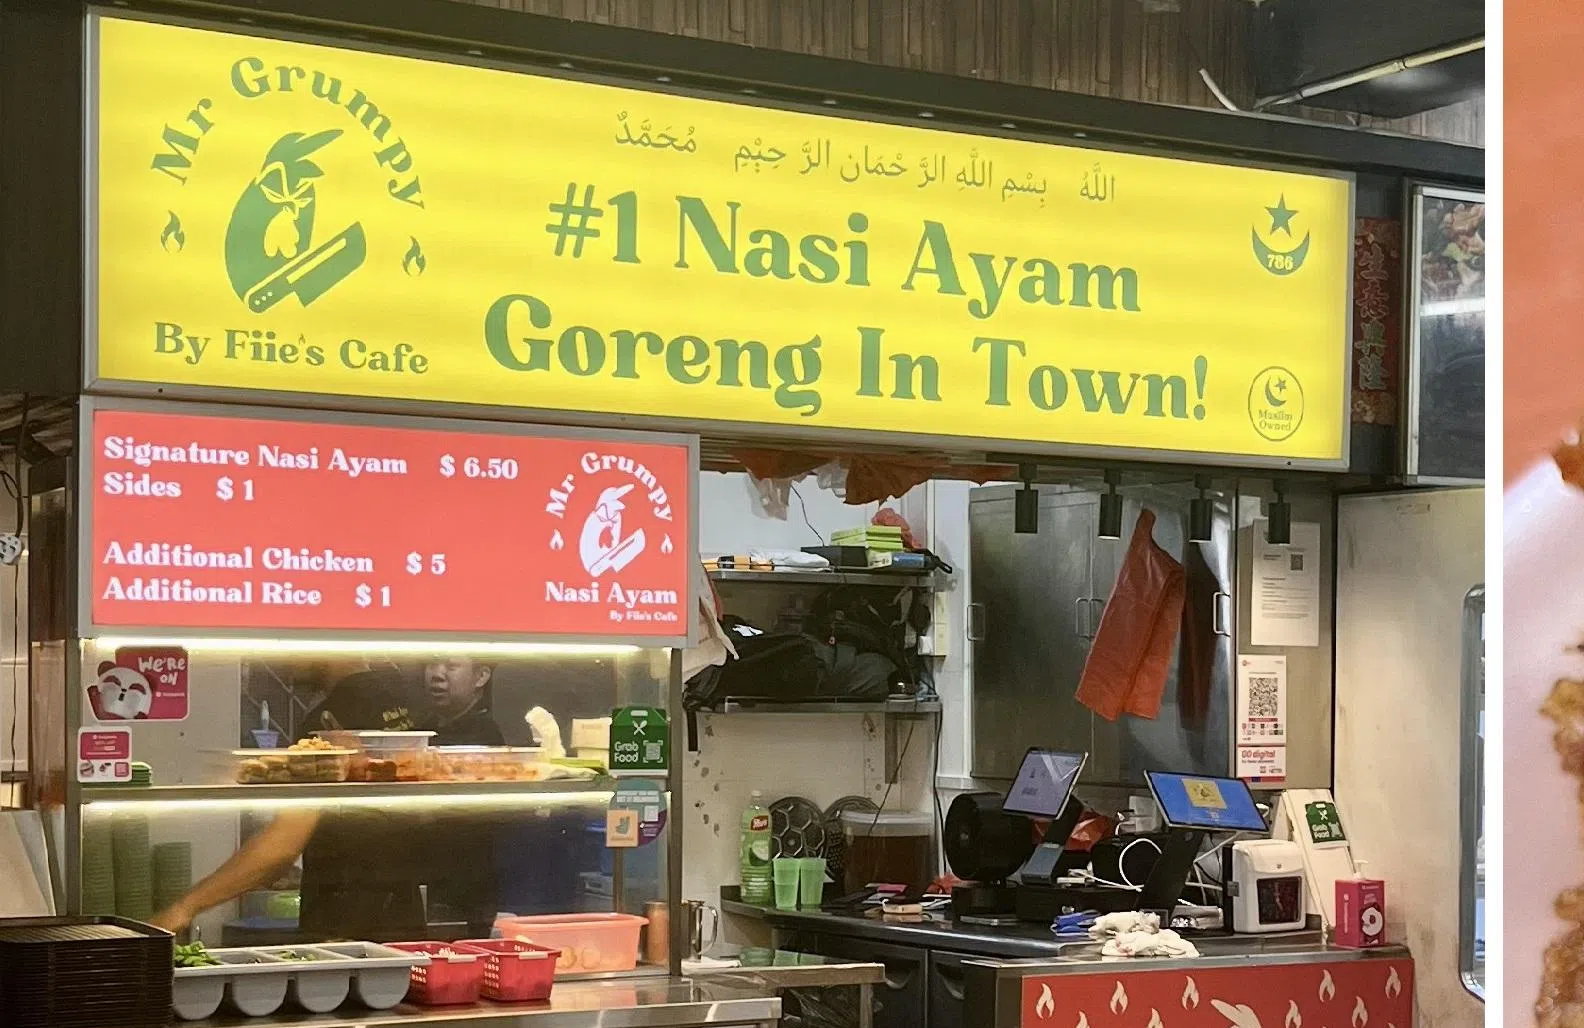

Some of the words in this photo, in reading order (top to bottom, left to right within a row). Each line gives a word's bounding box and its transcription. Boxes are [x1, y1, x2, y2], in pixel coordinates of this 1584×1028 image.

[150, 98, 215, 186] Mr
[230, 55, 426, 211] Grumpy
[546, 182, 641, 264] #1
[674, 195, 871, 287] Nasi
[900, 219, 1142, 320] Ayam
[1267, 253, 1294, 271] 786
[154, 321, 211, 365] By
[224, 329, 325, 367] Fiie's
[339, 339, 429, 375] Cafe
[483, 293, 822, 417] Goreng
[855, 326, 942, 402] In
[972, 336, 1208, 421] Town!
[1258, 410, 1293, 422] Muslim
[1259, 420, 1291, 431] Owned
[103, 436, 250, 468] Signature
[258, 444, 319, 470] Nasi
[327, 447, 407, 477] Ayam
[440, 454, 455, 478] $
[464, 456, 519, 480] 6.50
[103, 471, 182, 498] Sides
[216, 476, 234, 501] $
[242, 479, 255, 500] 1
[545, 473, 576, 519] Mr
[580, 452, 673, 522] Grumpy
[103, 541, 253, 569] Additional
[262, 547, 374, 573] Chicken
[406, 552, 423, 576] $
[430, 553, 446, 575] 5
[103, 576, 253, 604] Additional
[261, 581, 322, 606] Rice
[355, 583, 372, 608] $
[380, 585, 391, 607] 1
[545, 580, 600, 603] Nasi
[607, 581, 678, 609] Ayam
[609, 609, 624, 623] By
[653, 611, 678, 622] Cafe
[614, 741, 639, 752] Grab
[614, 752, 639, 763] Food
